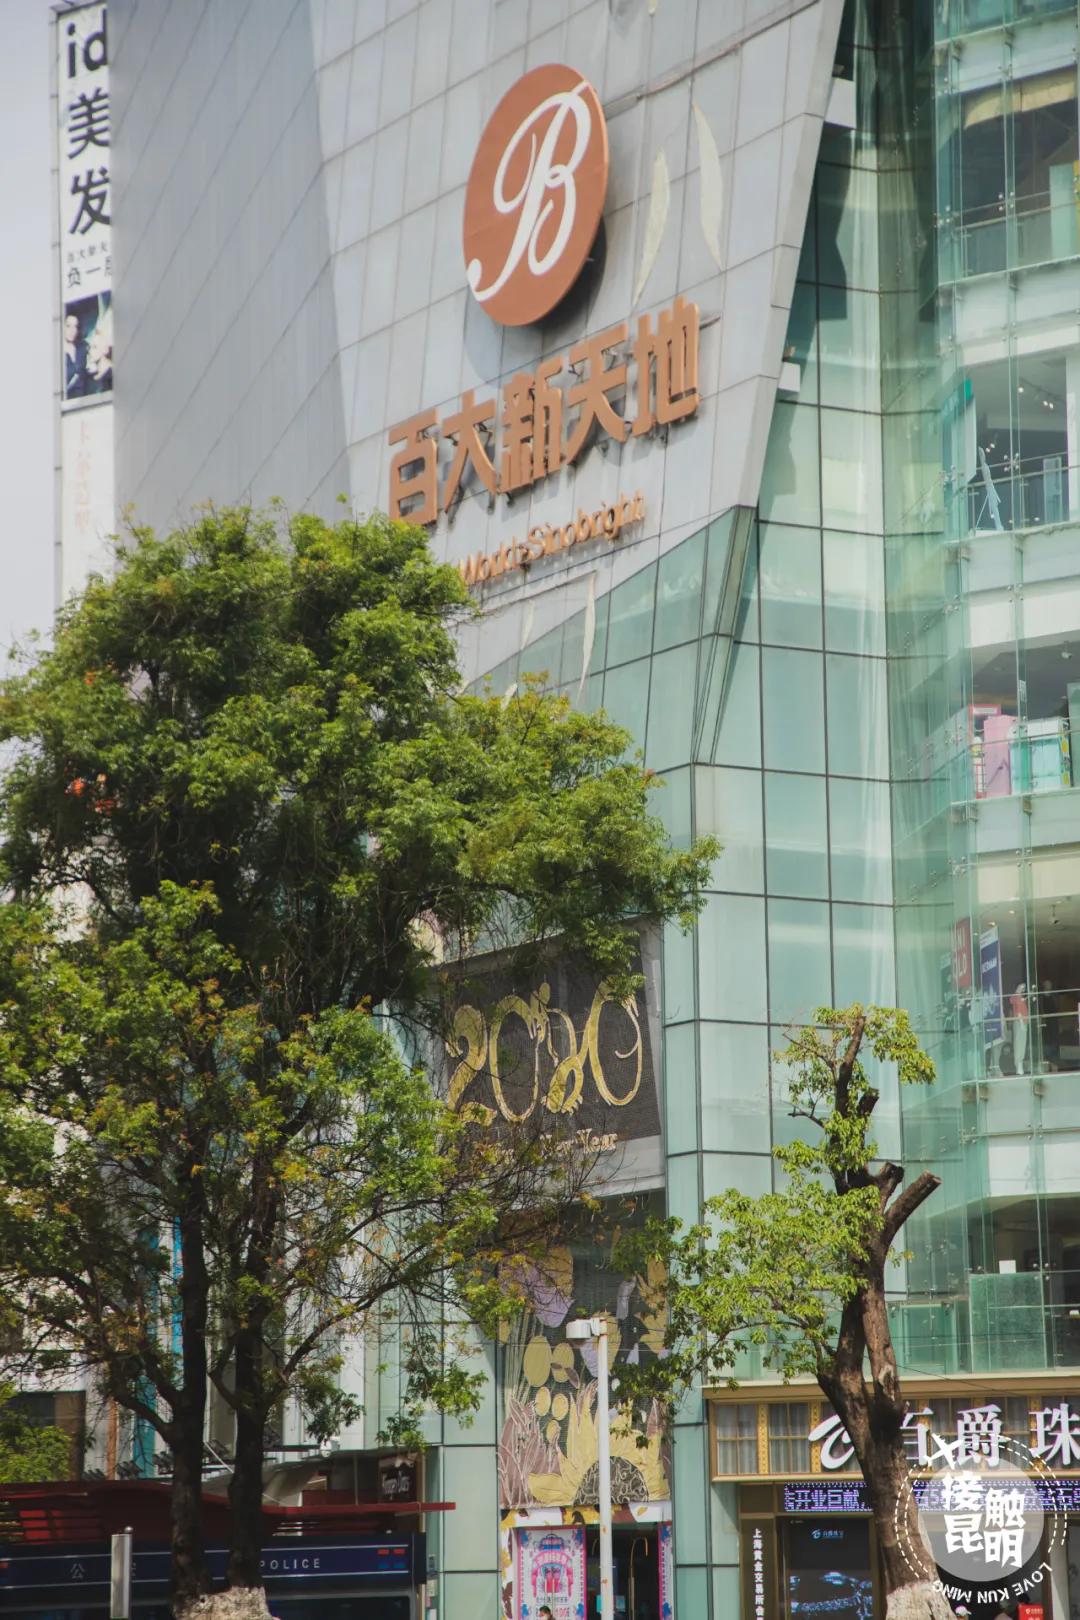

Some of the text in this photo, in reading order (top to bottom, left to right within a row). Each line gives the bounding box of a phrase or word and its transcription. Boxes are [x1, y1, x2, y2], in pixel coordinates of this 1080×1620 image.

[68, 87, 112, 235] 美发
[388, 296, 701, 528] 百大新天地
[576, 1128, 618, 1154] Year
[260, 1558, 320, 1571] POLICE
